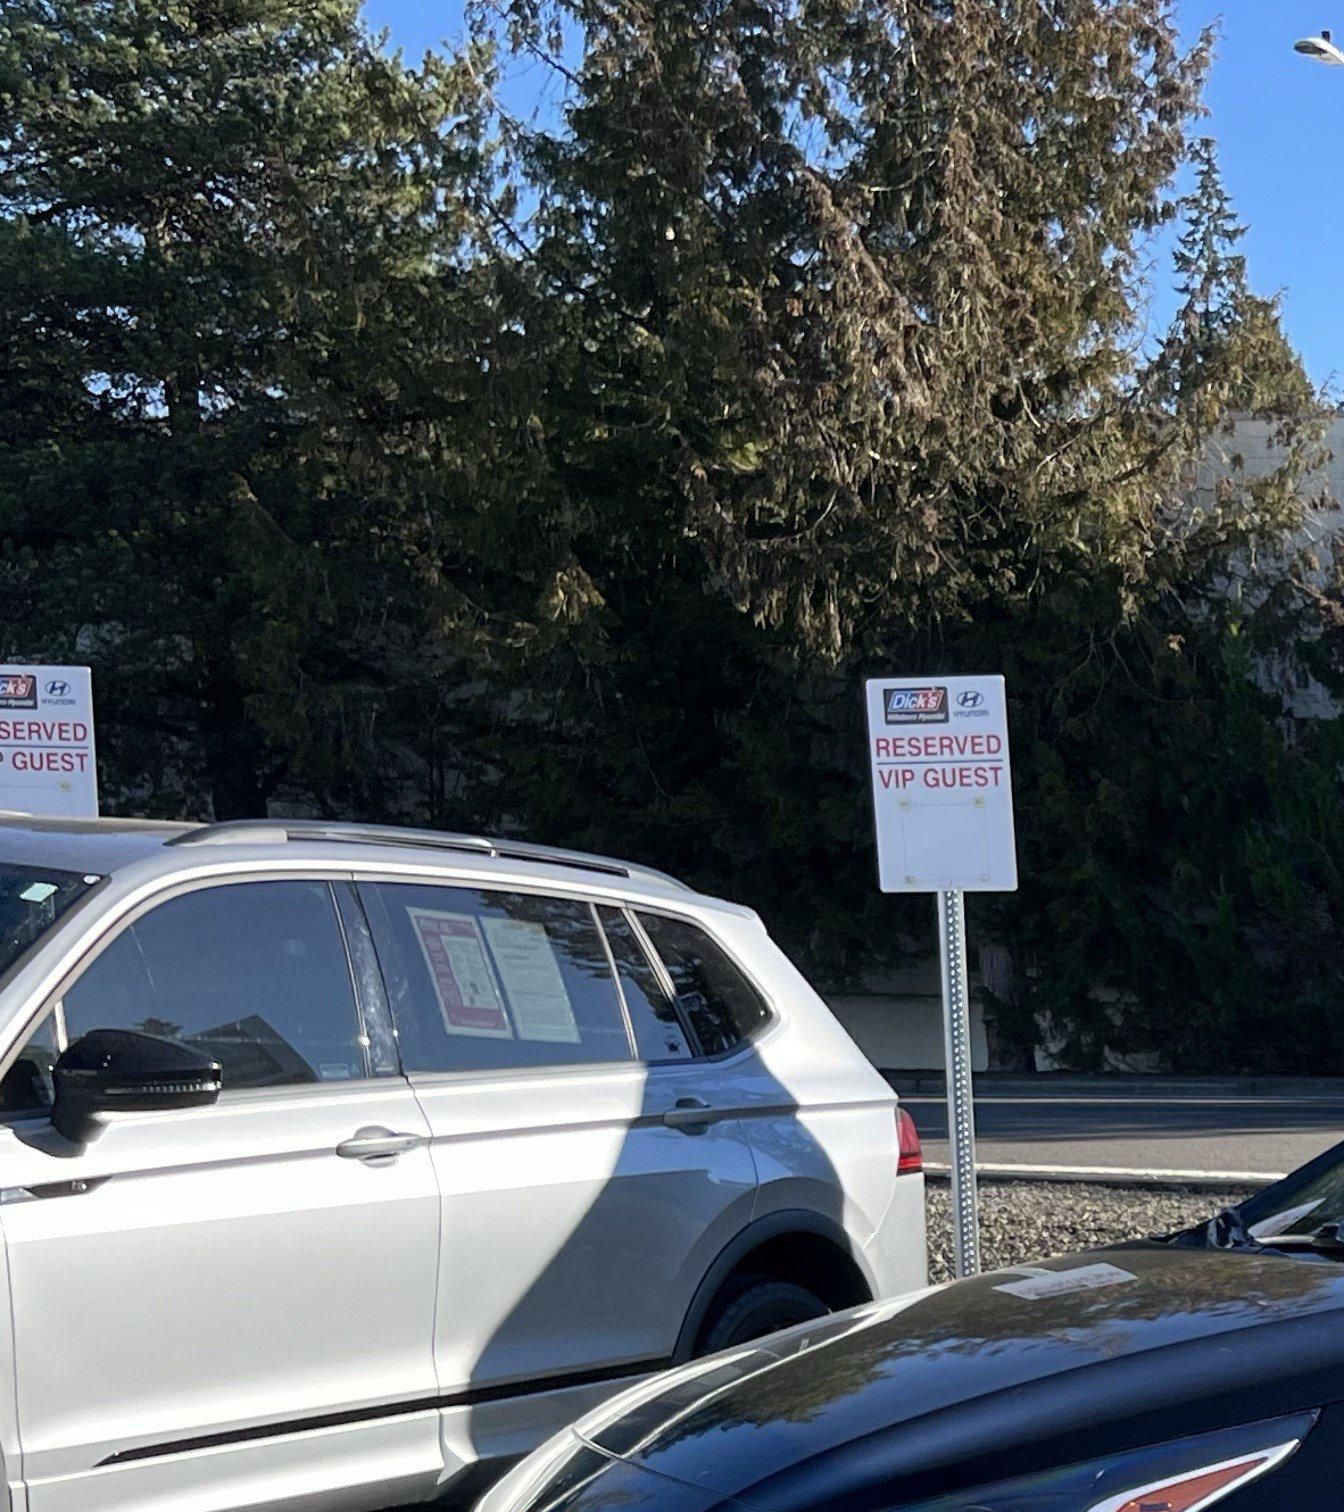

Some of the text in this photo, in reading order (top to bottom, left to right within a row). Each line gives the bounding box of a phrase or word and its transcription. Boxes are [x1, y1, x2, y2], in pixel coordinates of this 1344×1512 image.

[876, 735, 1001, 757] RESERVED
[12, 751, 88, 772] GUEST
[879, 767, 1002, 789] VIP GUEST
